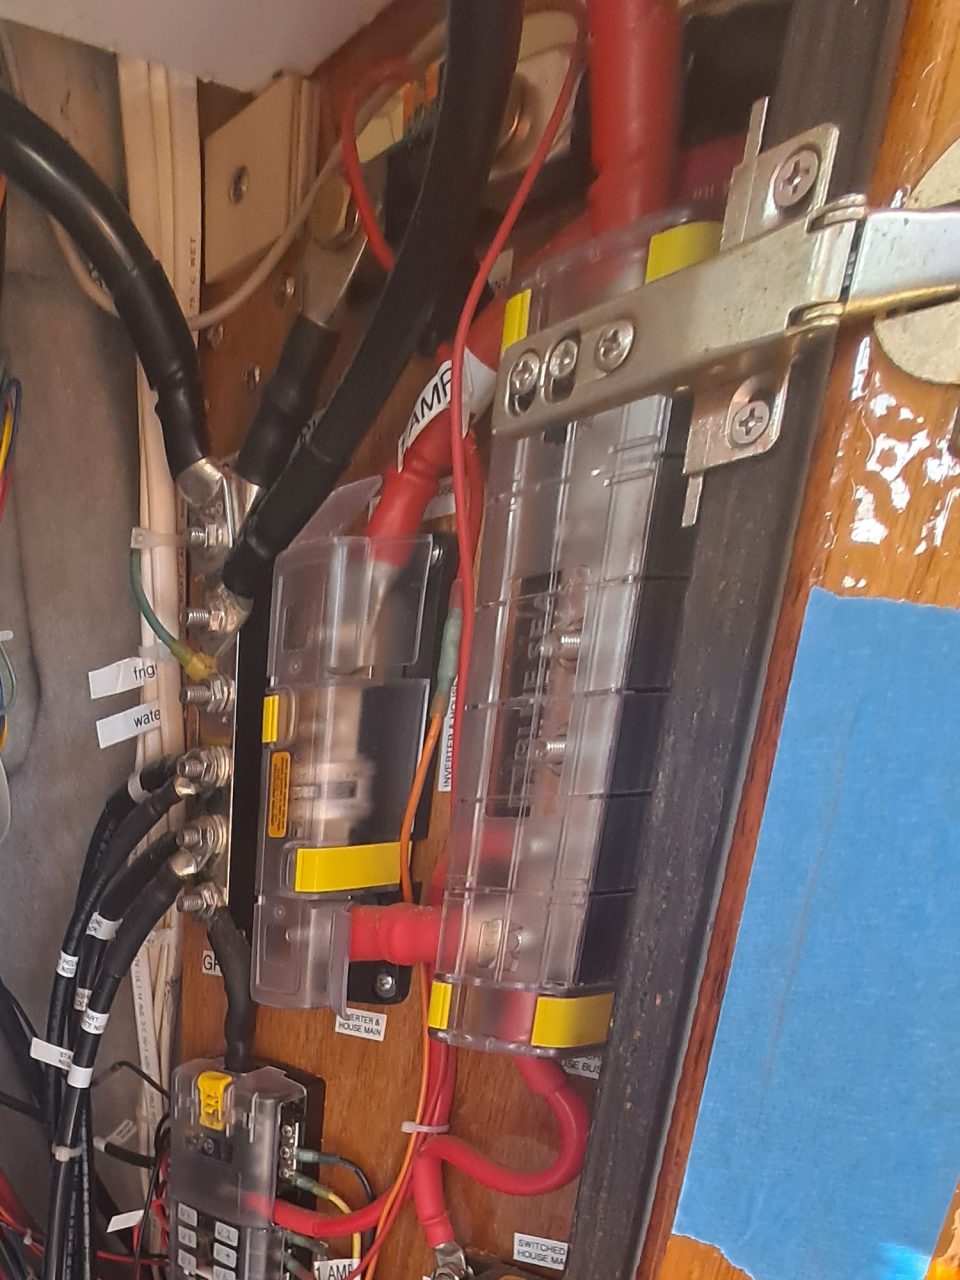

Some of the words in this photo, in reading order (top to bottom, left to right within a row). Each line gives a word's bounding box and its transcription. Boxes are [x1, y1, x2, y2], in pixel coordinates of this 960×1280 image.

[133, 709, 160, 728] wate
[339, 1020, 362, 1033] HOUSE
[363, 1024, 382, 1037] MAIN
[518, 1239, 566, 1256] SWITCHED
[517, 1250, 548, 1263] HOUSE
[551, 1256, 565, 1266] MA
